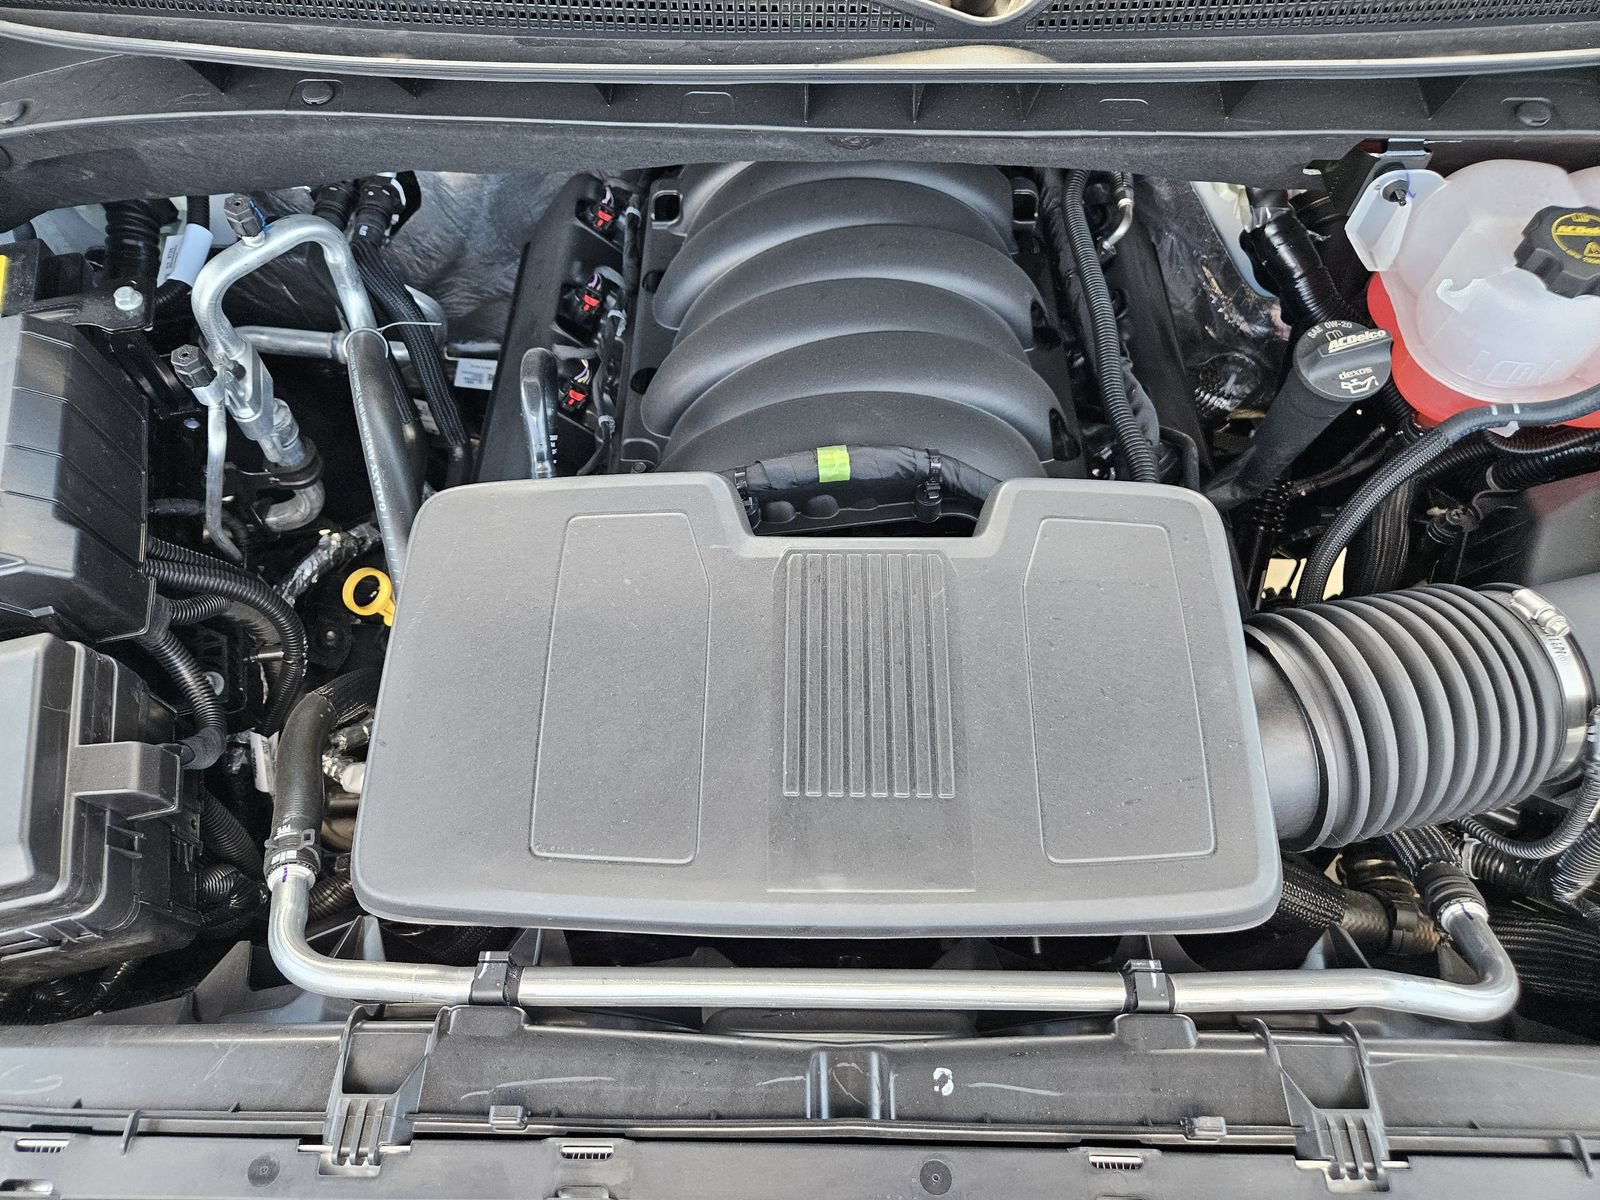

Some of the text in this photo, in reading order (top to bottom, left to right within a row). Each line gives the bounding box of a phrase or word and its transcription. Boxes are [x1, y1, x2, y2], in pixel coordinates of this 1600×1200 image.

[1307, 320, 1352, 338] SAE 0W-20
[1328, 329, 1386, 351] ACDelco
[1338, 366, 1373, 380] dexos
[370, 463, 386, 512] GALAXY
